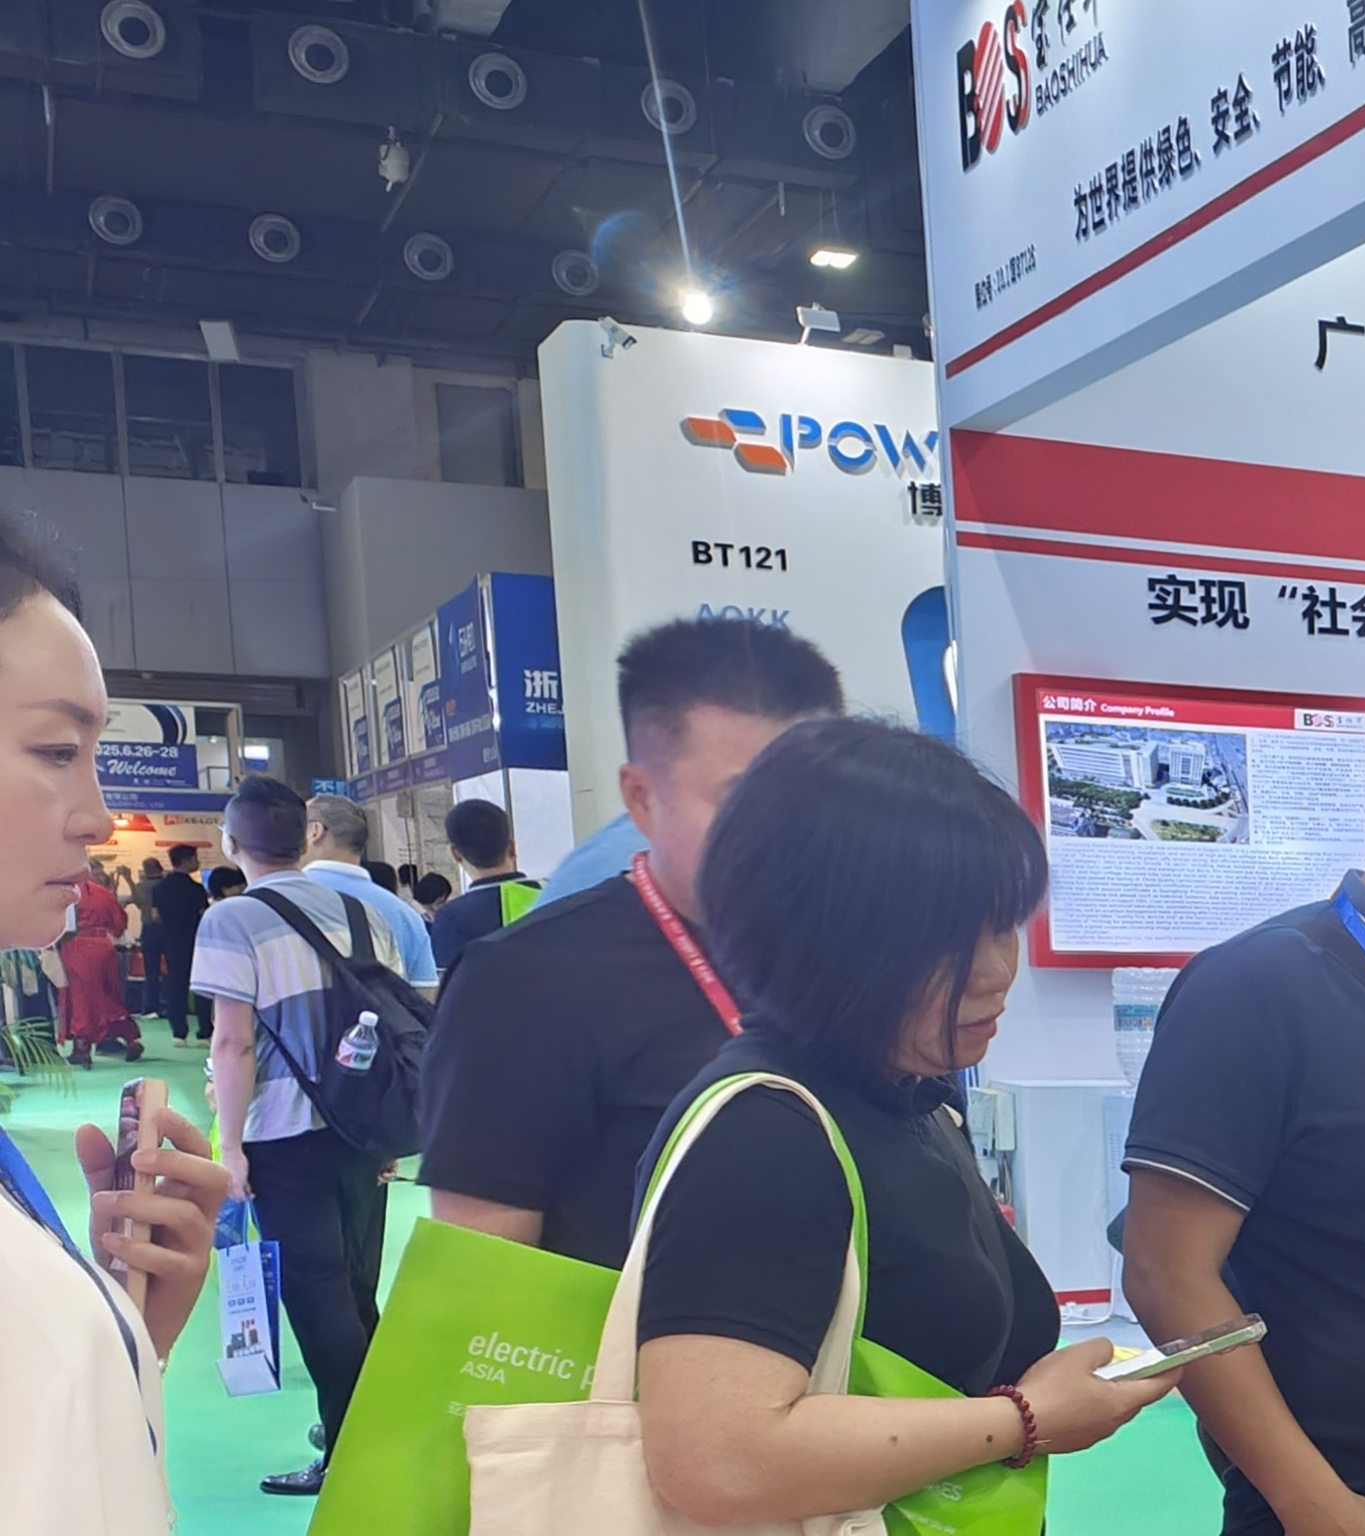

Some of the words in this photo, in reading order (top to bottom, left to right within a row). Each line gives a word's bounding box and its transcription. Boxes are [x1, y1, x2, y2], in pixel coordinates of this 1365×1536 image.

[1035, 31, 1108, 117] BAOSHIHUA
[691, 540, 788, 572] BT121
[523, 669, 558, 699] 浙
[1043, 696, 1097, 713] 公司简介
[1101, 703, 1143, 718] Company
[1145, 706, 1175, 718] Profile
[106, 759, 177, 777] Welcome
[468, 1332, 575, 1380] electric
[460, 1361, 506, 1384] ASIA
